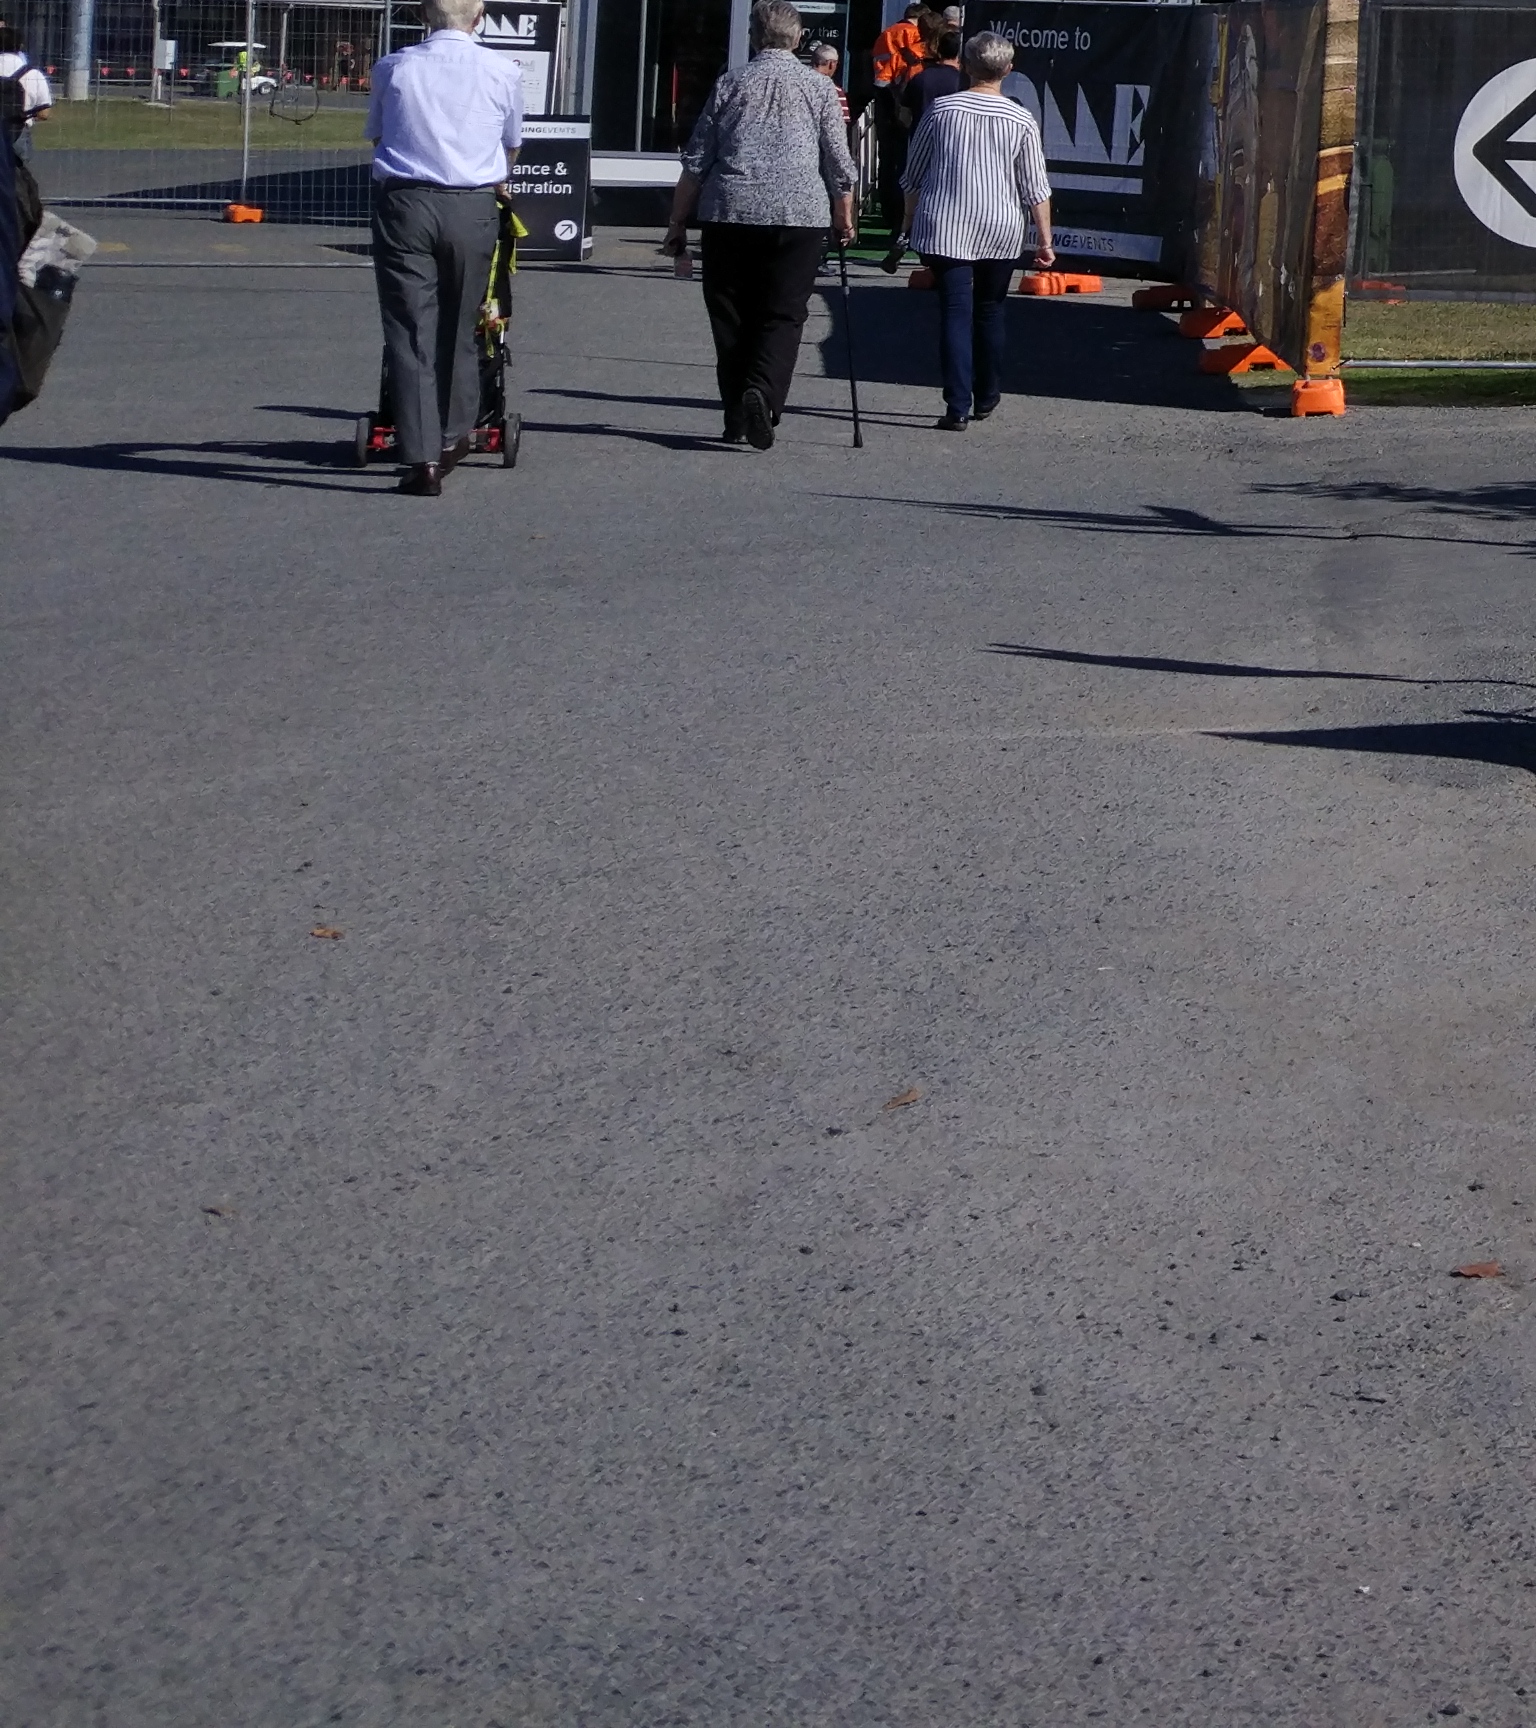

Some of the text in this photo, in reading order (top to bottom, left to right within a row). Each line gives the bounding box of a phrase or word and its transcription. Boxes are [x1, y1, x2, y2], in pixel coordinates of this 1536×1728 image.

[1074, 26, 1091, 51] to
[555, 161, 567, 176] &
[505, 179, 572, 195] istration
